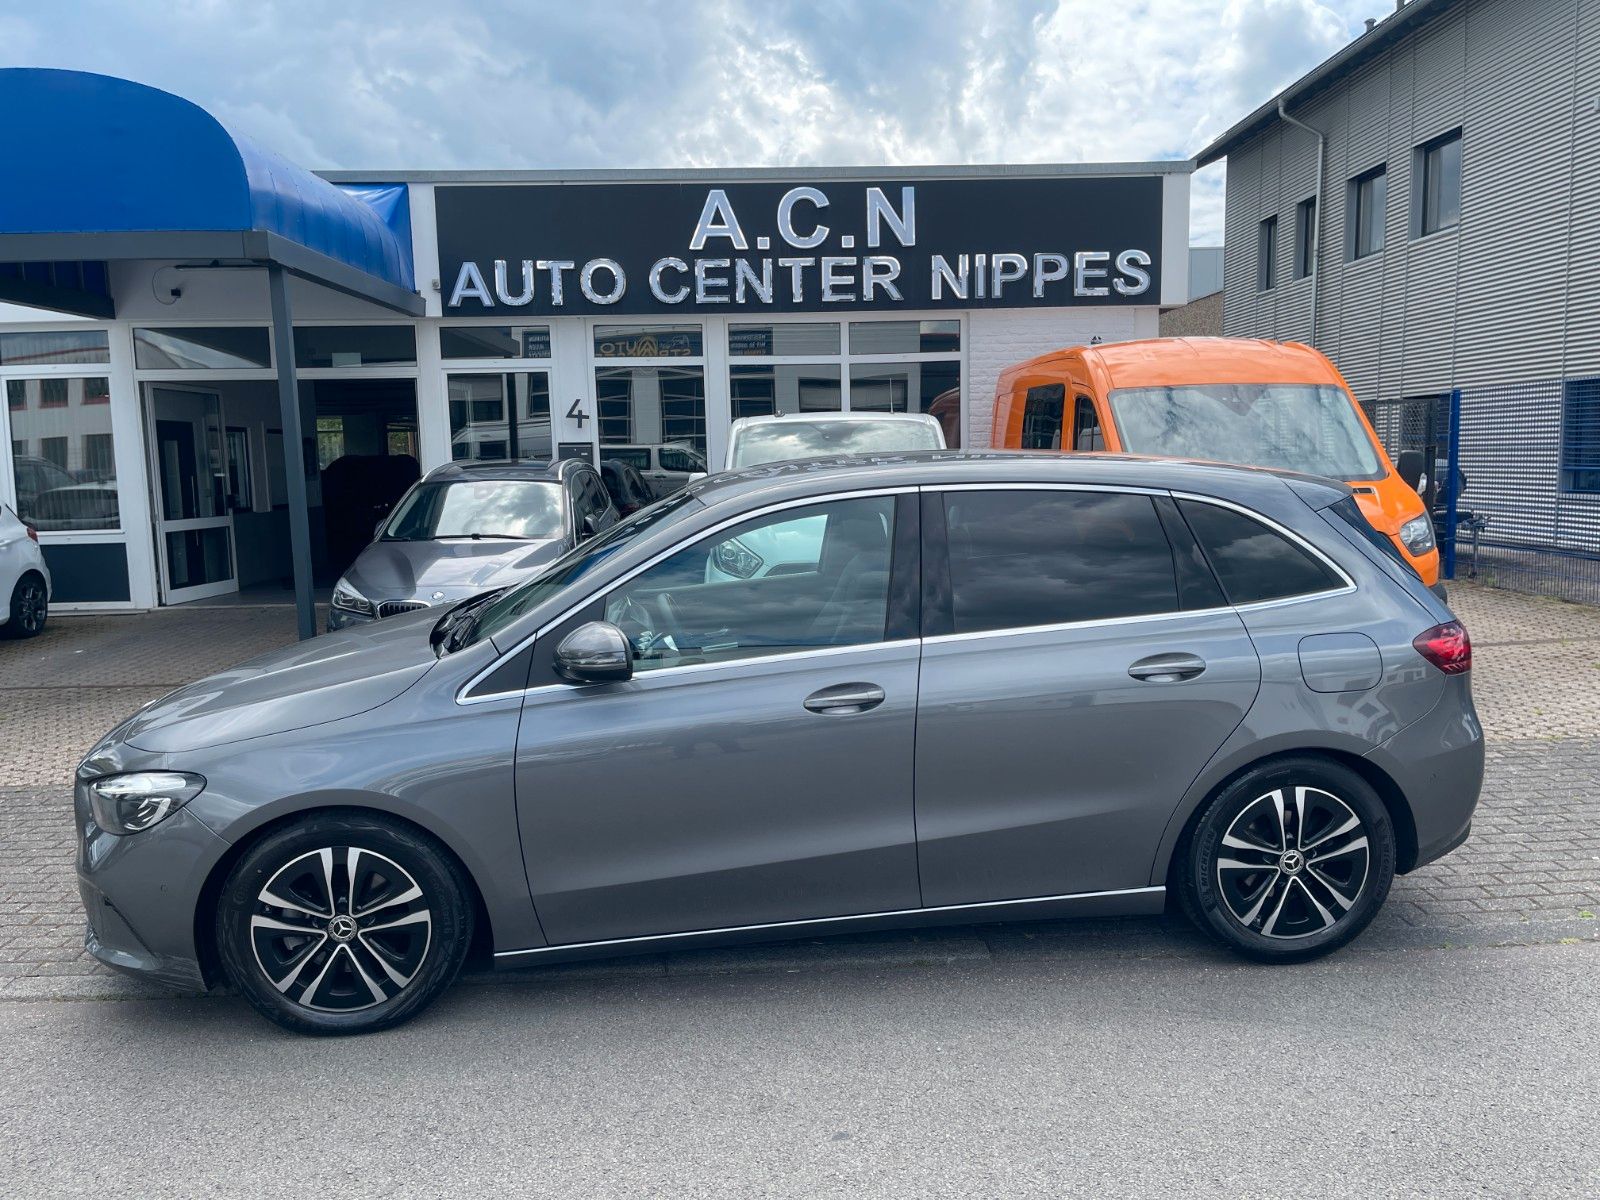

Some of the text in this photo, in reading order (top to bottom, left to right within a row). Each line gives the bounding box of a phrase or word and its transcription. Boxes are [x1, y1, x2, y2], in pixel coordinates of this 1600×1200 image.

[689, 187, 915, 250] A.C.N
[448, 250, 1152, 307] AUTO CENTER NIPPES
[566, 399, 589, 428] 4
